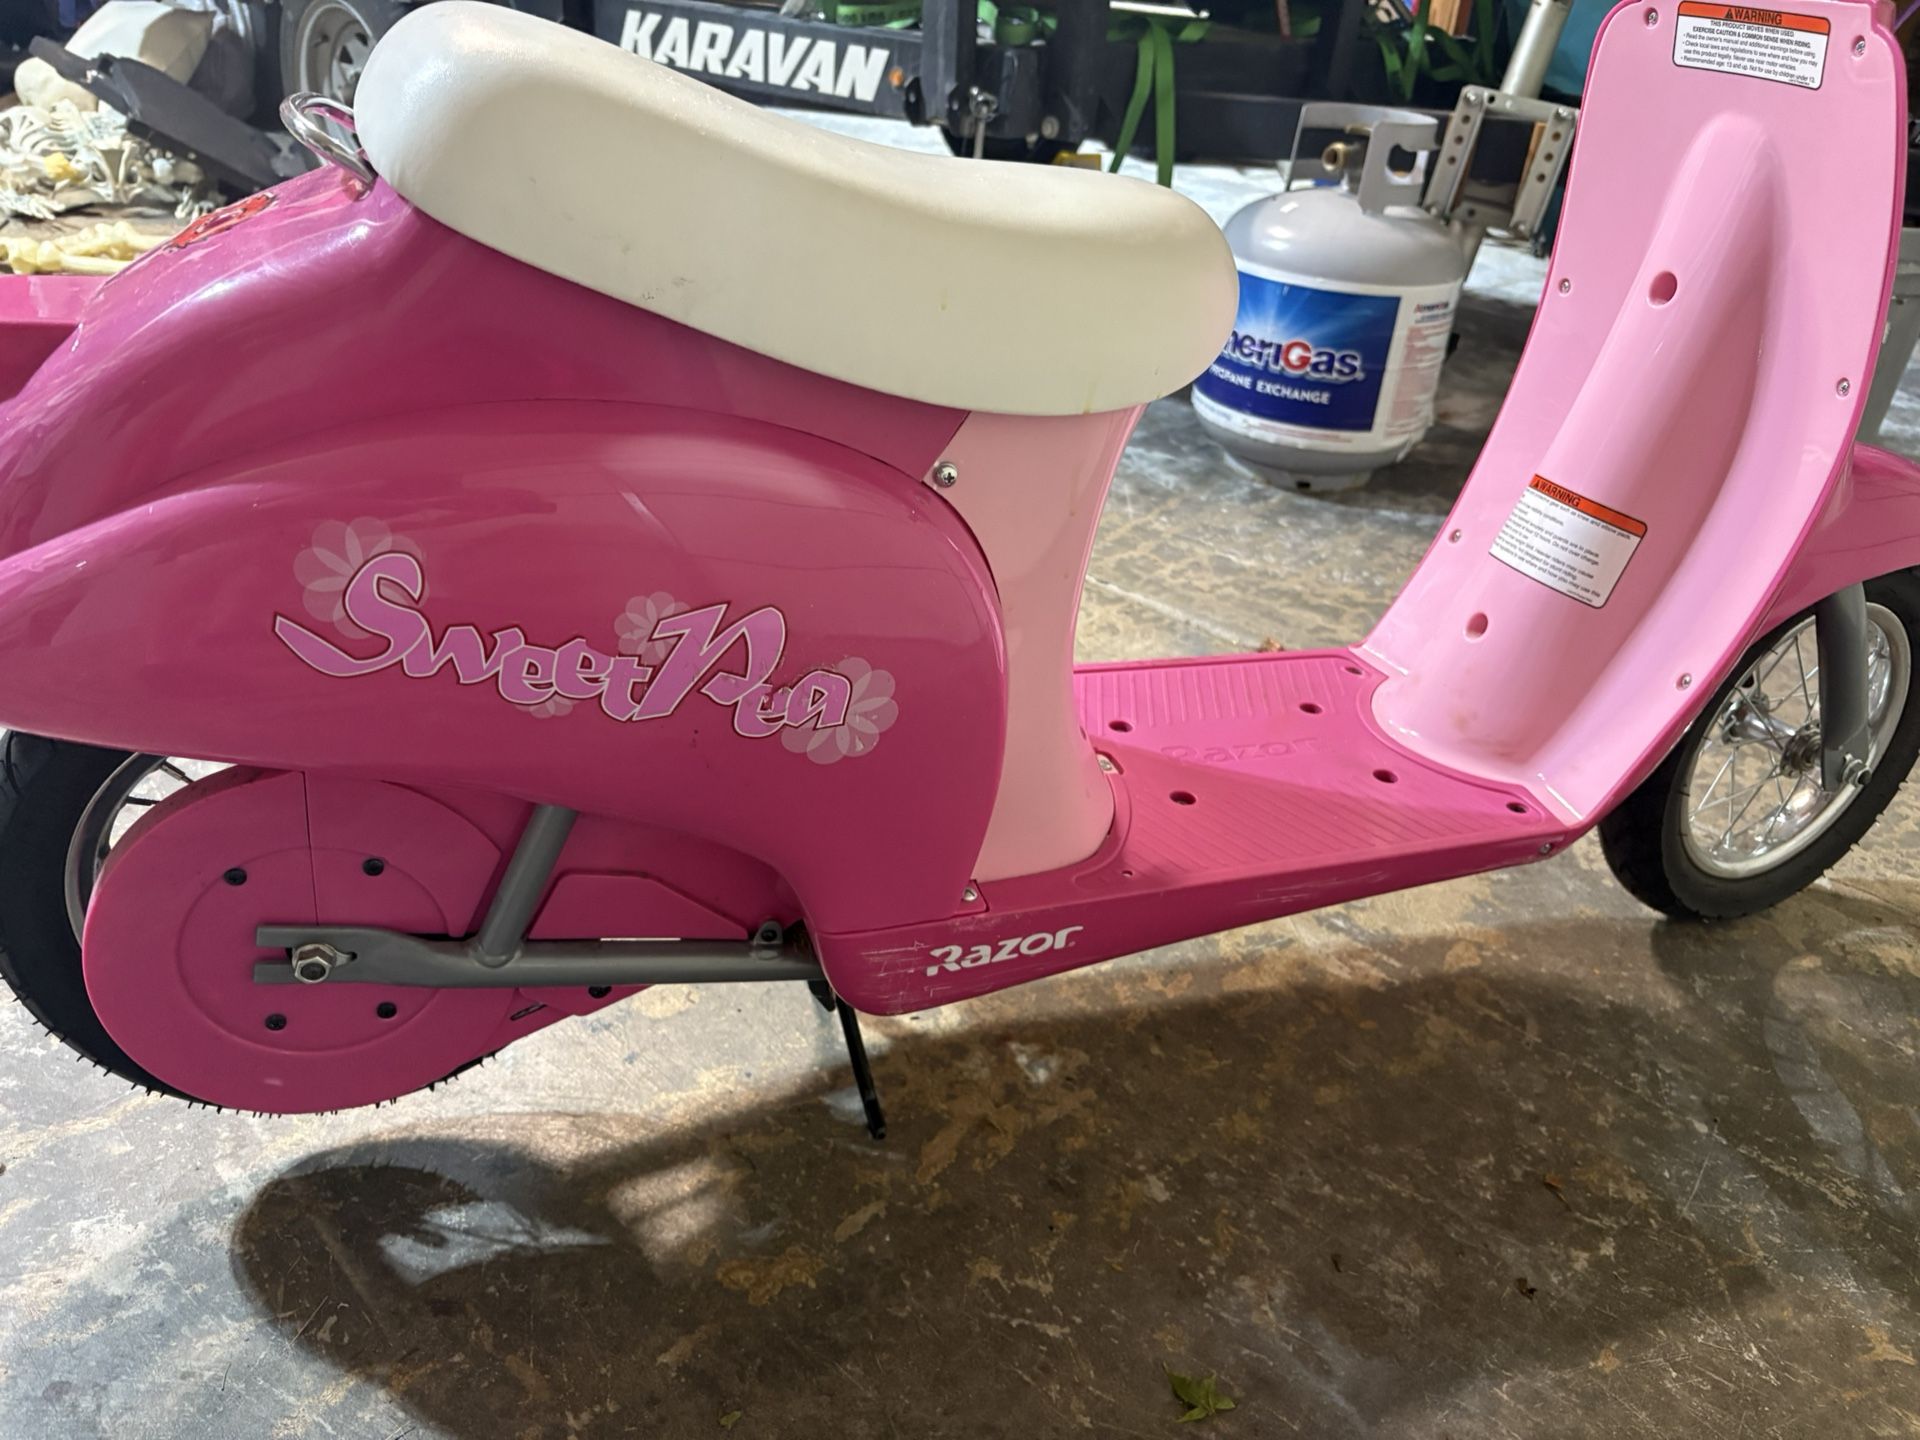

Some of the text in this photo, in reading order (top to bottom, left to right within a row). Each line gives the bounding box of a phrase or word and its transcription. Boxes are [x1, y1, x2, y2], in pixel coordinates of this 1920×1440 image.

[1722, 21, 1745, 30] PRODUCT
[1746, 24, 1764, 32] MOVES
[1734, 8, 1783, 26] WARNING
[1692, 25, 1715, 34] EXERCISE
[1715, 28, 1736, 36] CAUTION
[1741, 31, 1762, 40] COMMON
[1762, 34, 1778, 42] SENSE
[620, 9, 890, 102] KARAVAN
[1224, 330, 1359, 377] eriGas
[1256, 379, 1331, 405] EXCHANGE
[1539, 481, 1581, 507] WARNING
[274, 551, 852, 738] Sweet Pea
[926, 926, 1083, 977] Razor
